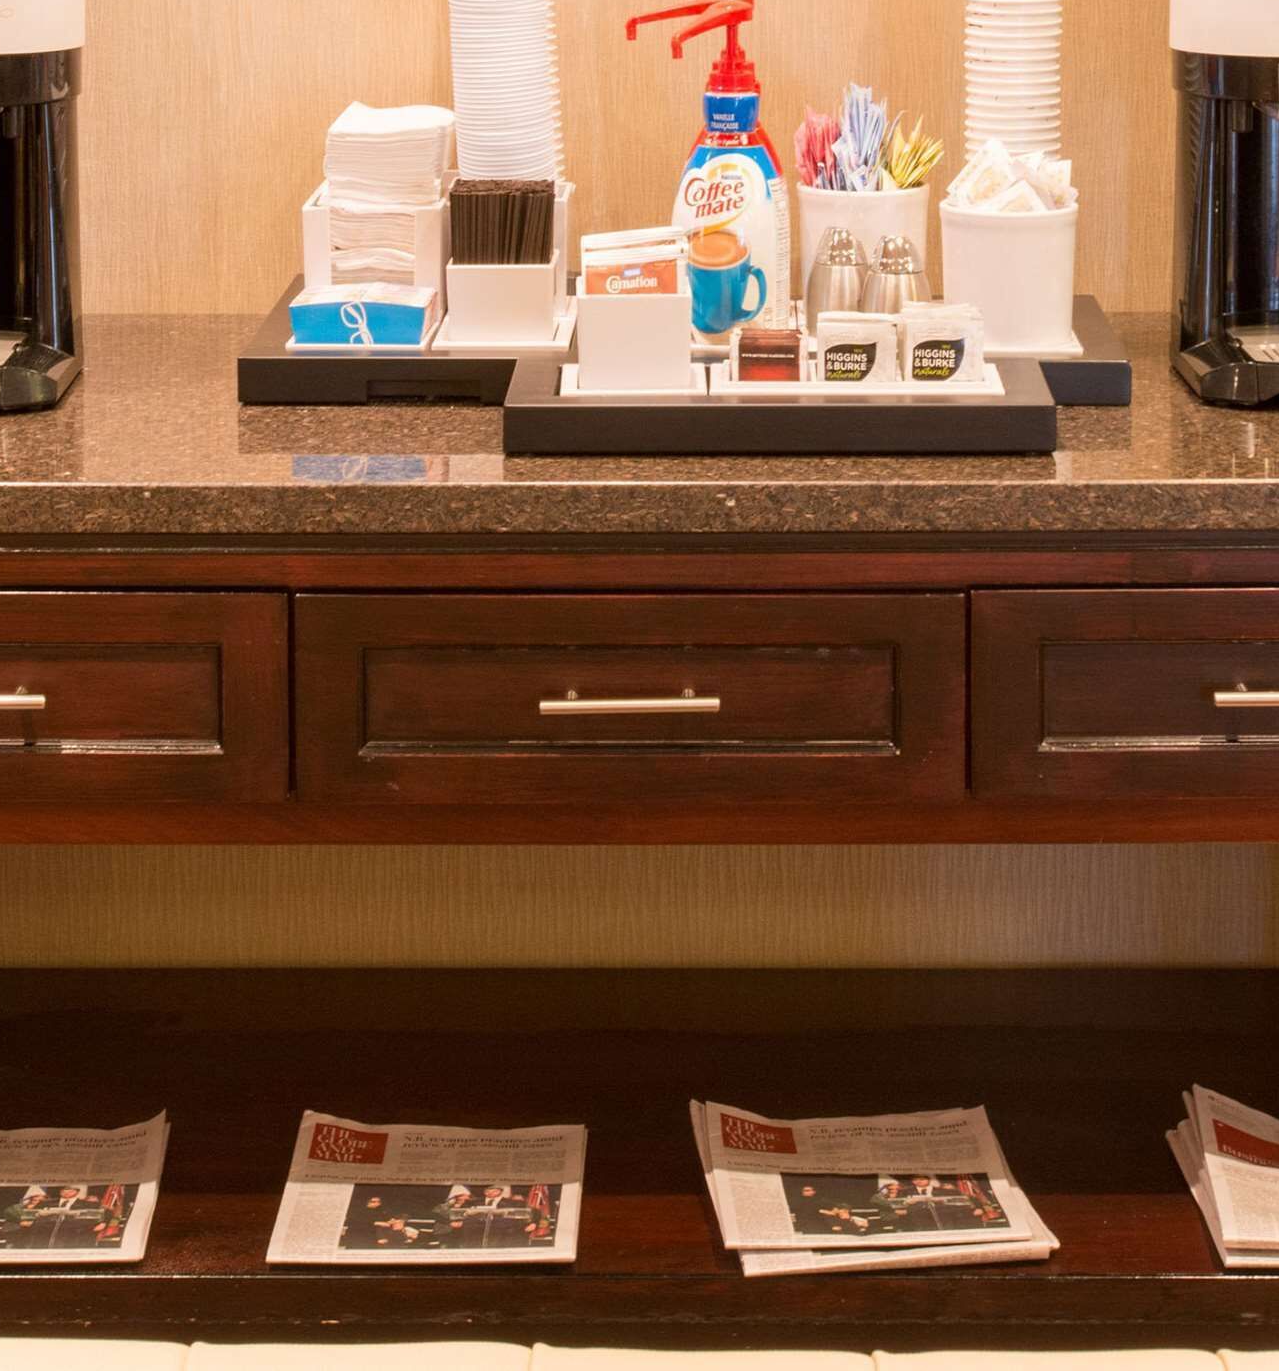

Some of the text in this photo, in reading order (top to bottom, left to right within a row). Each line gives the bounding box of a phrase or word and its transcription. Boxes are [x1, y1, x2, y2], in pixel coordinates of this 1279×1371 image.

[685, 177, 745, 207] Coffee
[695, 196, 745, 218] mate
[826, 352, 868, 362] HIGGINS
[914, 349, 956, 358] HIGGINS
